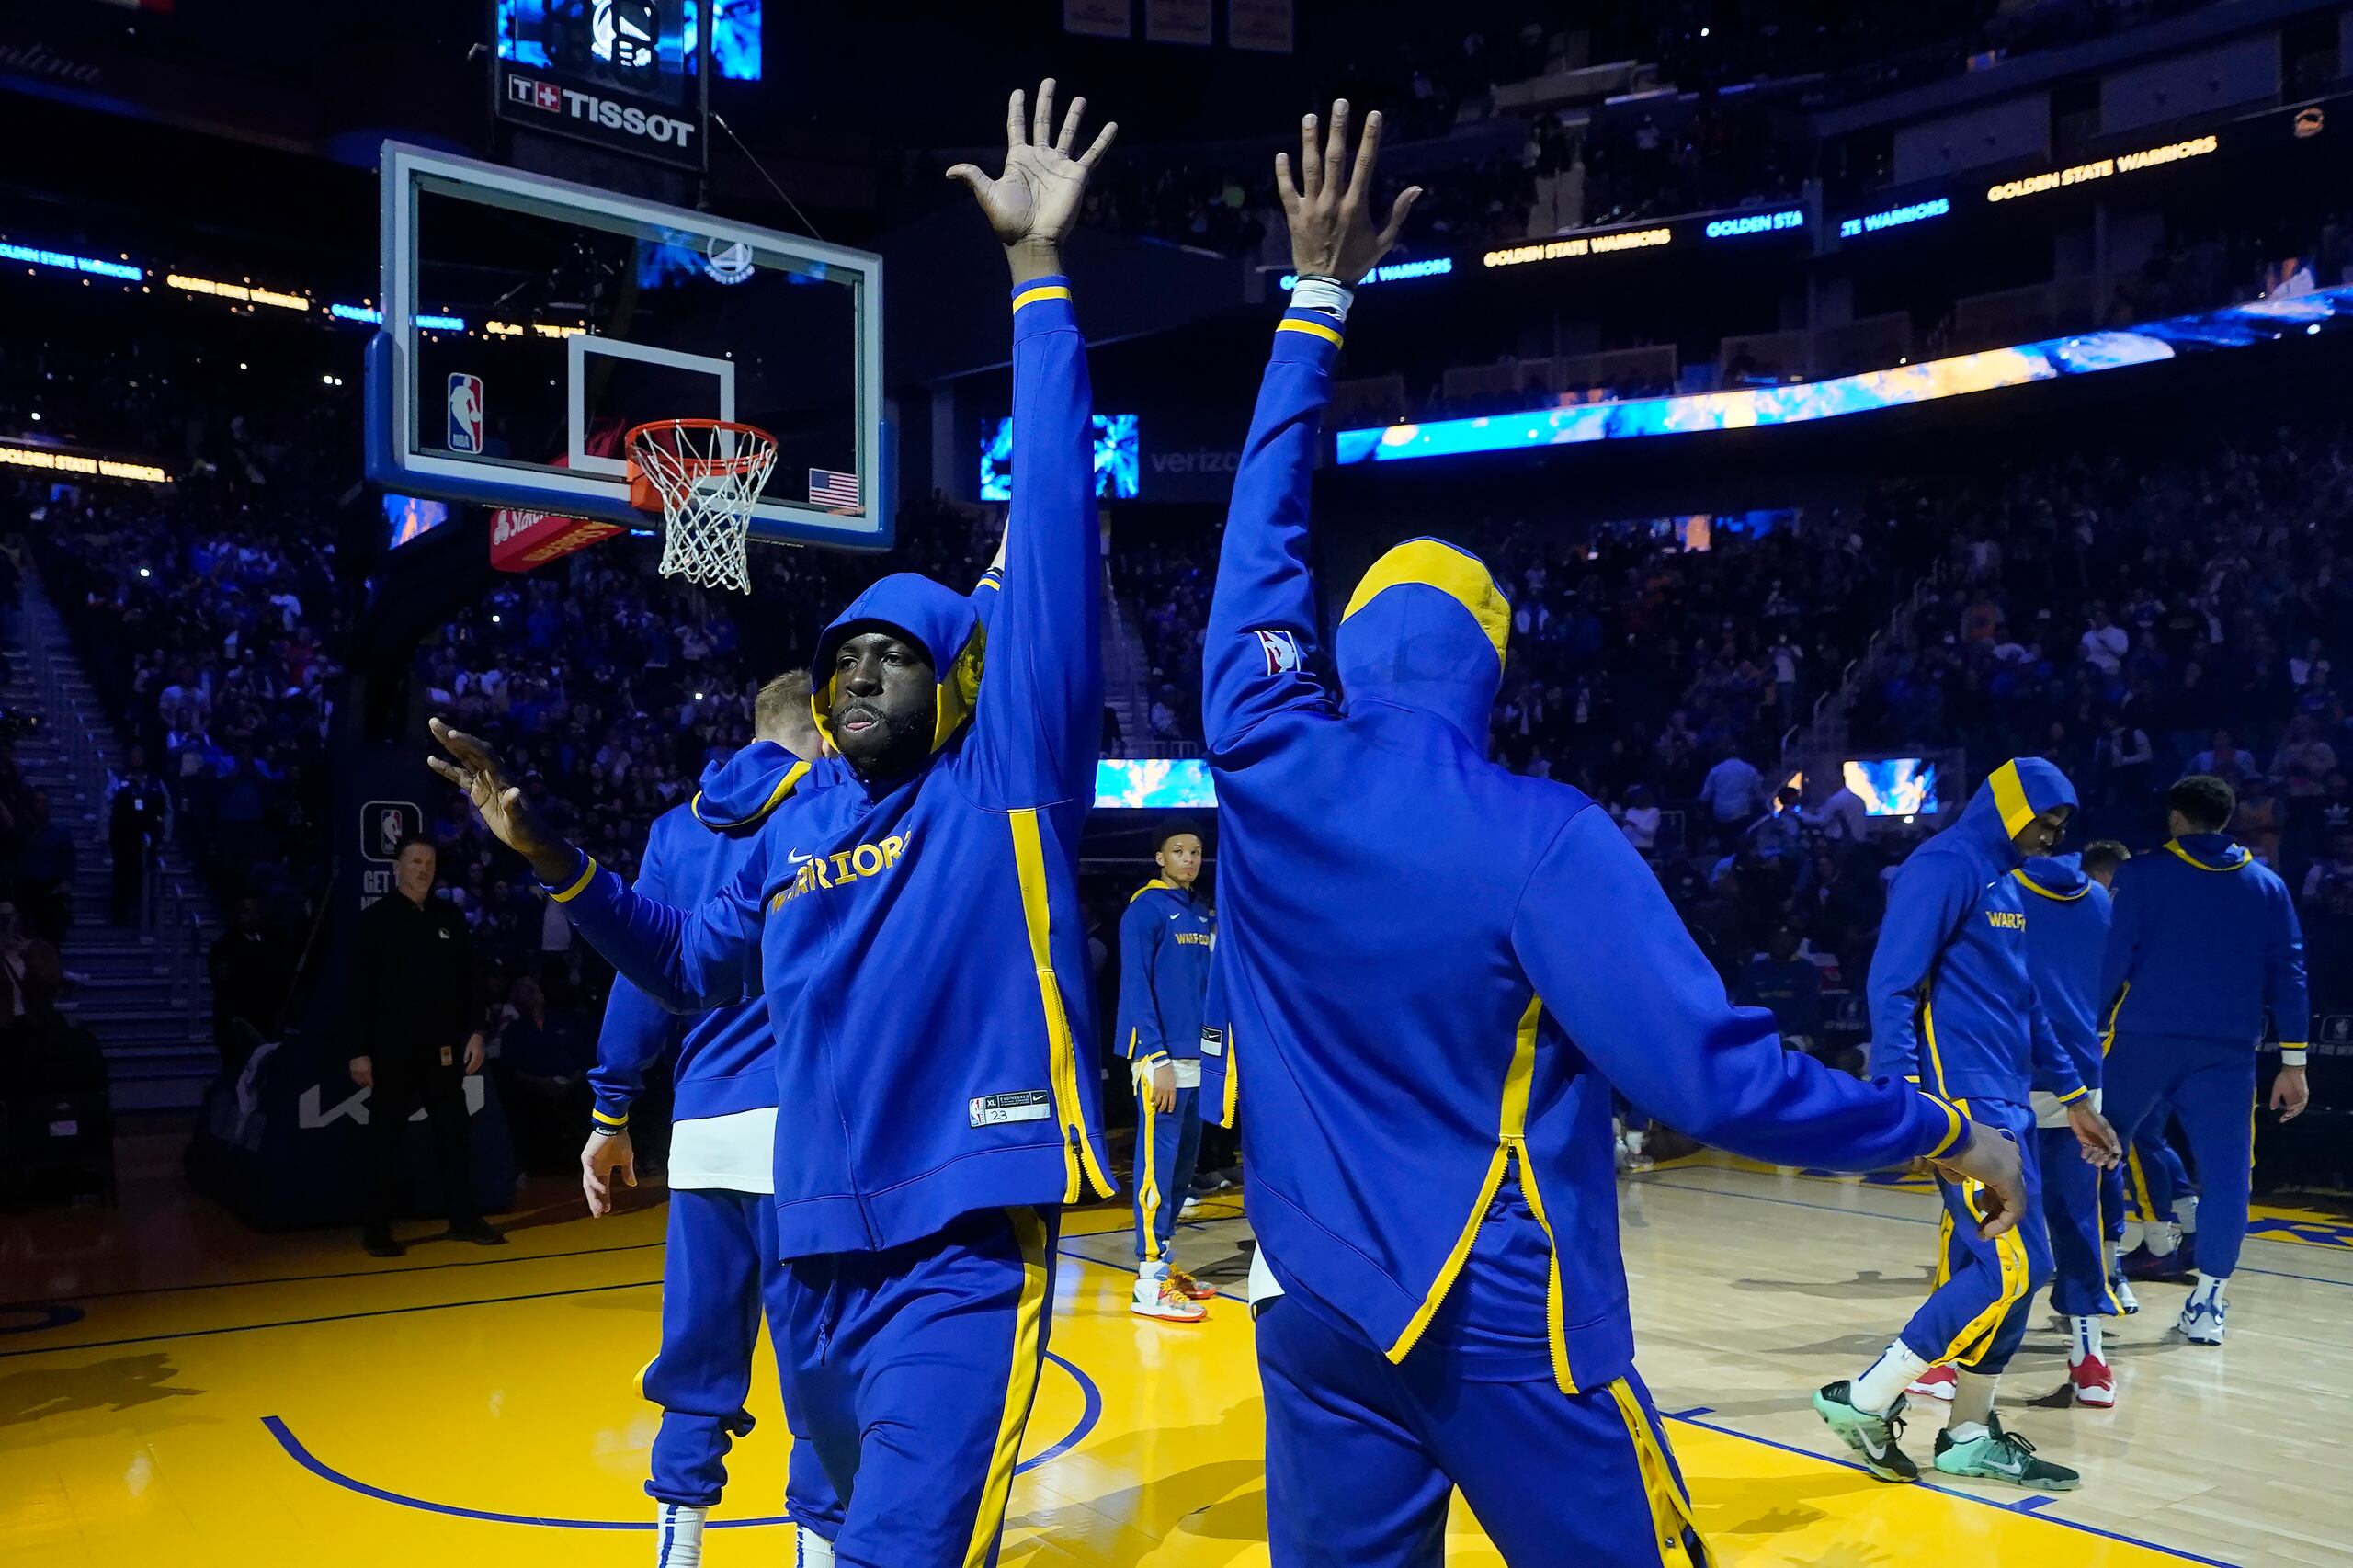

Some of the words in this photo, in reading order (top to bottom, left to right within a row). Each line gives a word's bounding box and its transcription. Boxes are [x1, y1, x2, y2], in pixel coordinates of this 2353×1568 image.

[562, 89, 696, 147] TISSOT
[1987, 172, 2061, 202] GOLDEN
[2061, 159, 2114, 186] STATE
[2116, 135, 2218, 173] WARRIORS
[1706, 214, 1773, 238] GOLDEN
[1840, 218, 1863, 238] TE
[1864, 198, 1949, 232] WARRIORS
[1483, 244, 1545, 267] GOLDEN
[1545, 239, 1589, 259] STATE
[1590, 228, 1672, 254] WARRIORS
[990, 1110, 1008, 1121] 23
